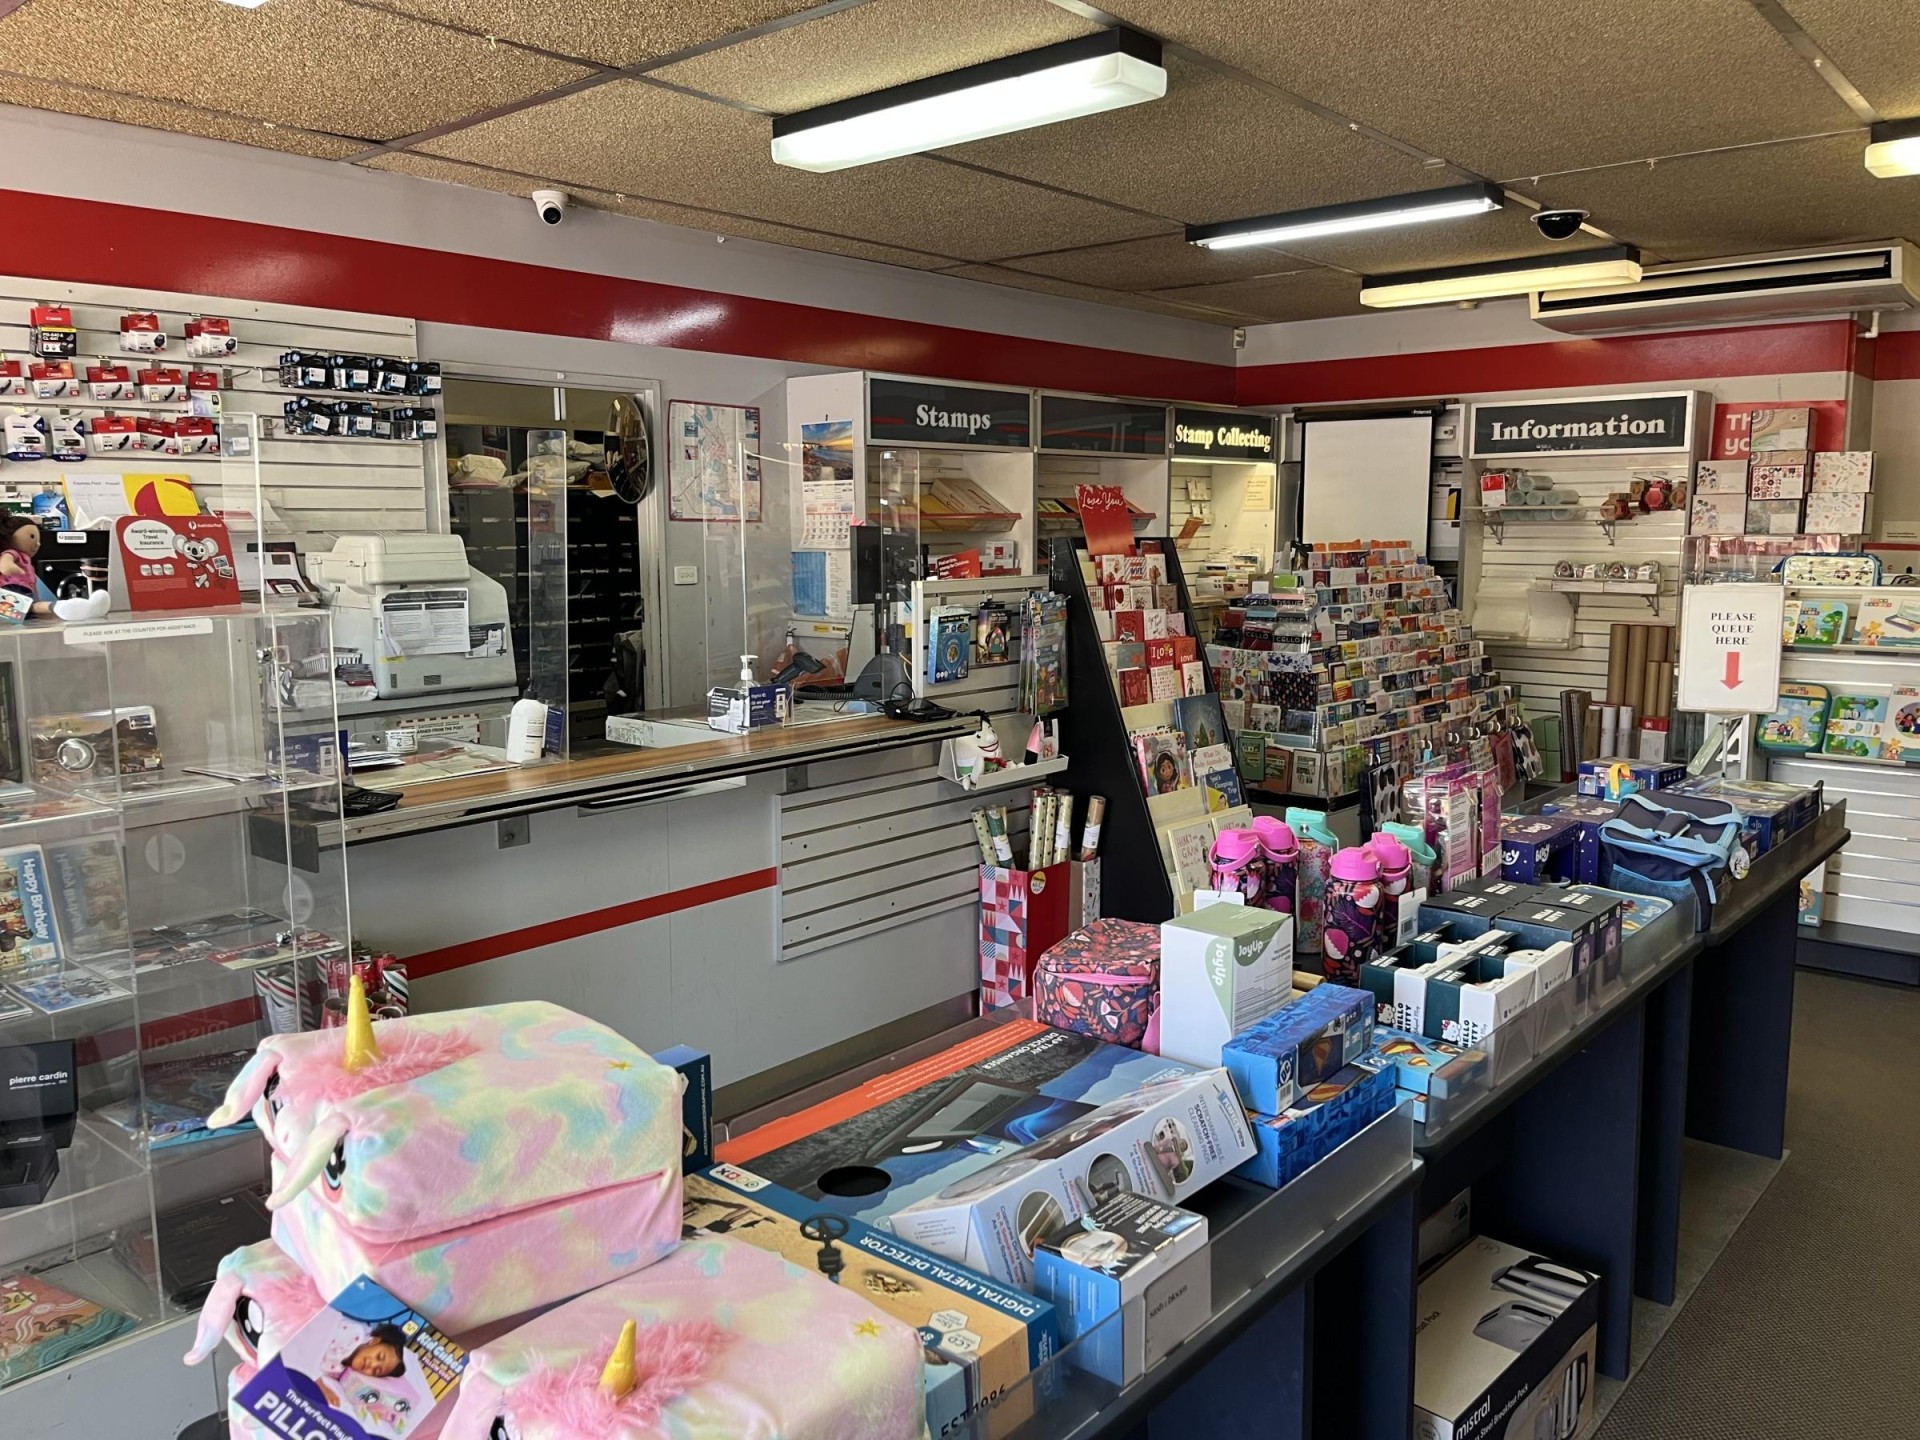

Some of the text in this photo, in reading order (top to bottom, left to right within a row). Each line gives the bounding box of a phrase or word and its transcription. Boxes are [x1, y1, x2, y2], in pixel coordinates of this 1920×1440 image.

[916, 404, 991, 435] Stamps
[1491, 414, 1666, 441] Information
[1175, 424, 1271, 452] Stamp Collecting
[1101, 492, 1124, 510] You
[1711, 612, 1757, 621] PLEASE
[1711, 624, 1754, 634] QUEUE
[1245, 631, 1269, 640] CELLO
[1715, 636, 1749, 645] HERE
[1181, 654, 1194, 662] LOVE
[1227, 786, 1238, 796] Trip
[23, 858, 49, 940] Happy Birthday
[1238, 939, 1264, 957] JoyUp
[1211, 943, 1227, 986] JoyUp
[1396, 1002, 1404, 1031] HELLO
[1030, 1033, 1069, 1055] LAP TRAY
[1460, 1019, 1470, 1048] HELLO
[1470, 1021, 1479, 1047] ITTY
[981, 1031, 1060, 1070] DEVICE ORGANISER
[9, 1075, 38, 1086] pierre
[38, 1070, 68, 1083] cardin
[1281, 1063, 1291, 1081] DC
[1187, 1107, 1211, 1165] CLEANING PADS
[1193, 1103, 1217, 1161] SCRATCH-FREE
[1062, 1181, 1075, 1213] Cleaning
[1001, 1205, 1014, 1241] Captures
[1012, 1241, 1021, 1261] Dirty
[859, 1235, 931, 1271] DETECTOR
[930, 1266, 975, 1292] METAL
[974, 1288, 1035, 1317] DIGITAL
[948, 1336, 971, 1350] LCD
[284, 1388, 332, 1427] The Perfect
[1456, 1394, 1491, 1440] mistral
[1480, 1383, 1529, 1439] Steel Breakfast Pack
